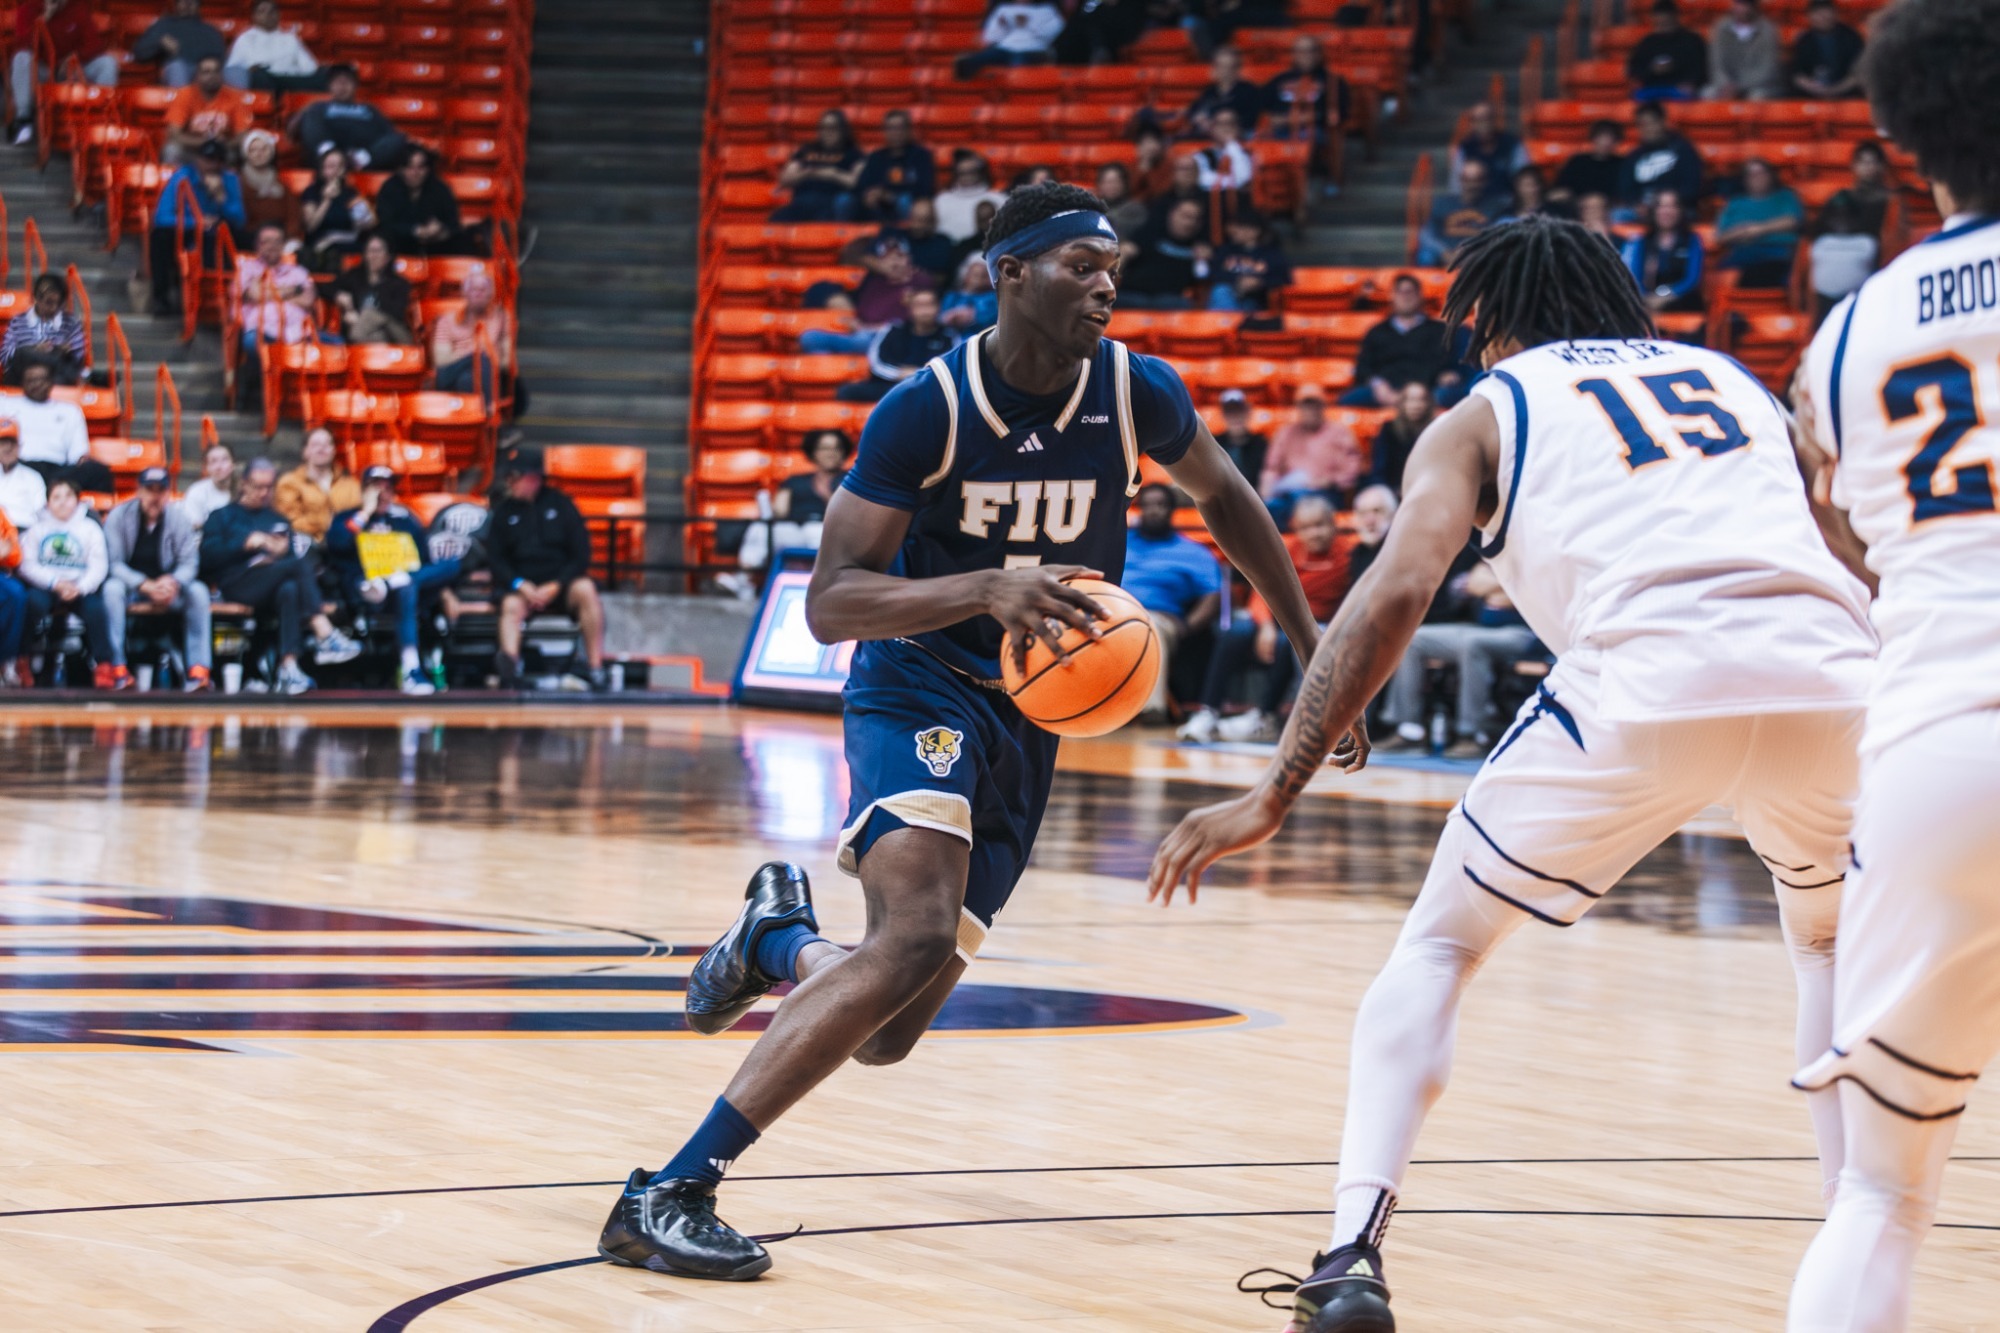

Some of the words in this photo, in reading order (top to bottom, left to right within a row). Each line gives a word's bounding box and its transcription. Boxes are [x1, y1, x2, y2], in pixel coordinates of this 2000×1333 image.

[1918, 257, 2000, 324] BROO
[1549, 347, 1629, 366] WEST
[1570, 366, 1753, 476] 15
[1878, 349, 2000, 532] 2
[959, 479, 1097, 544] FIU
